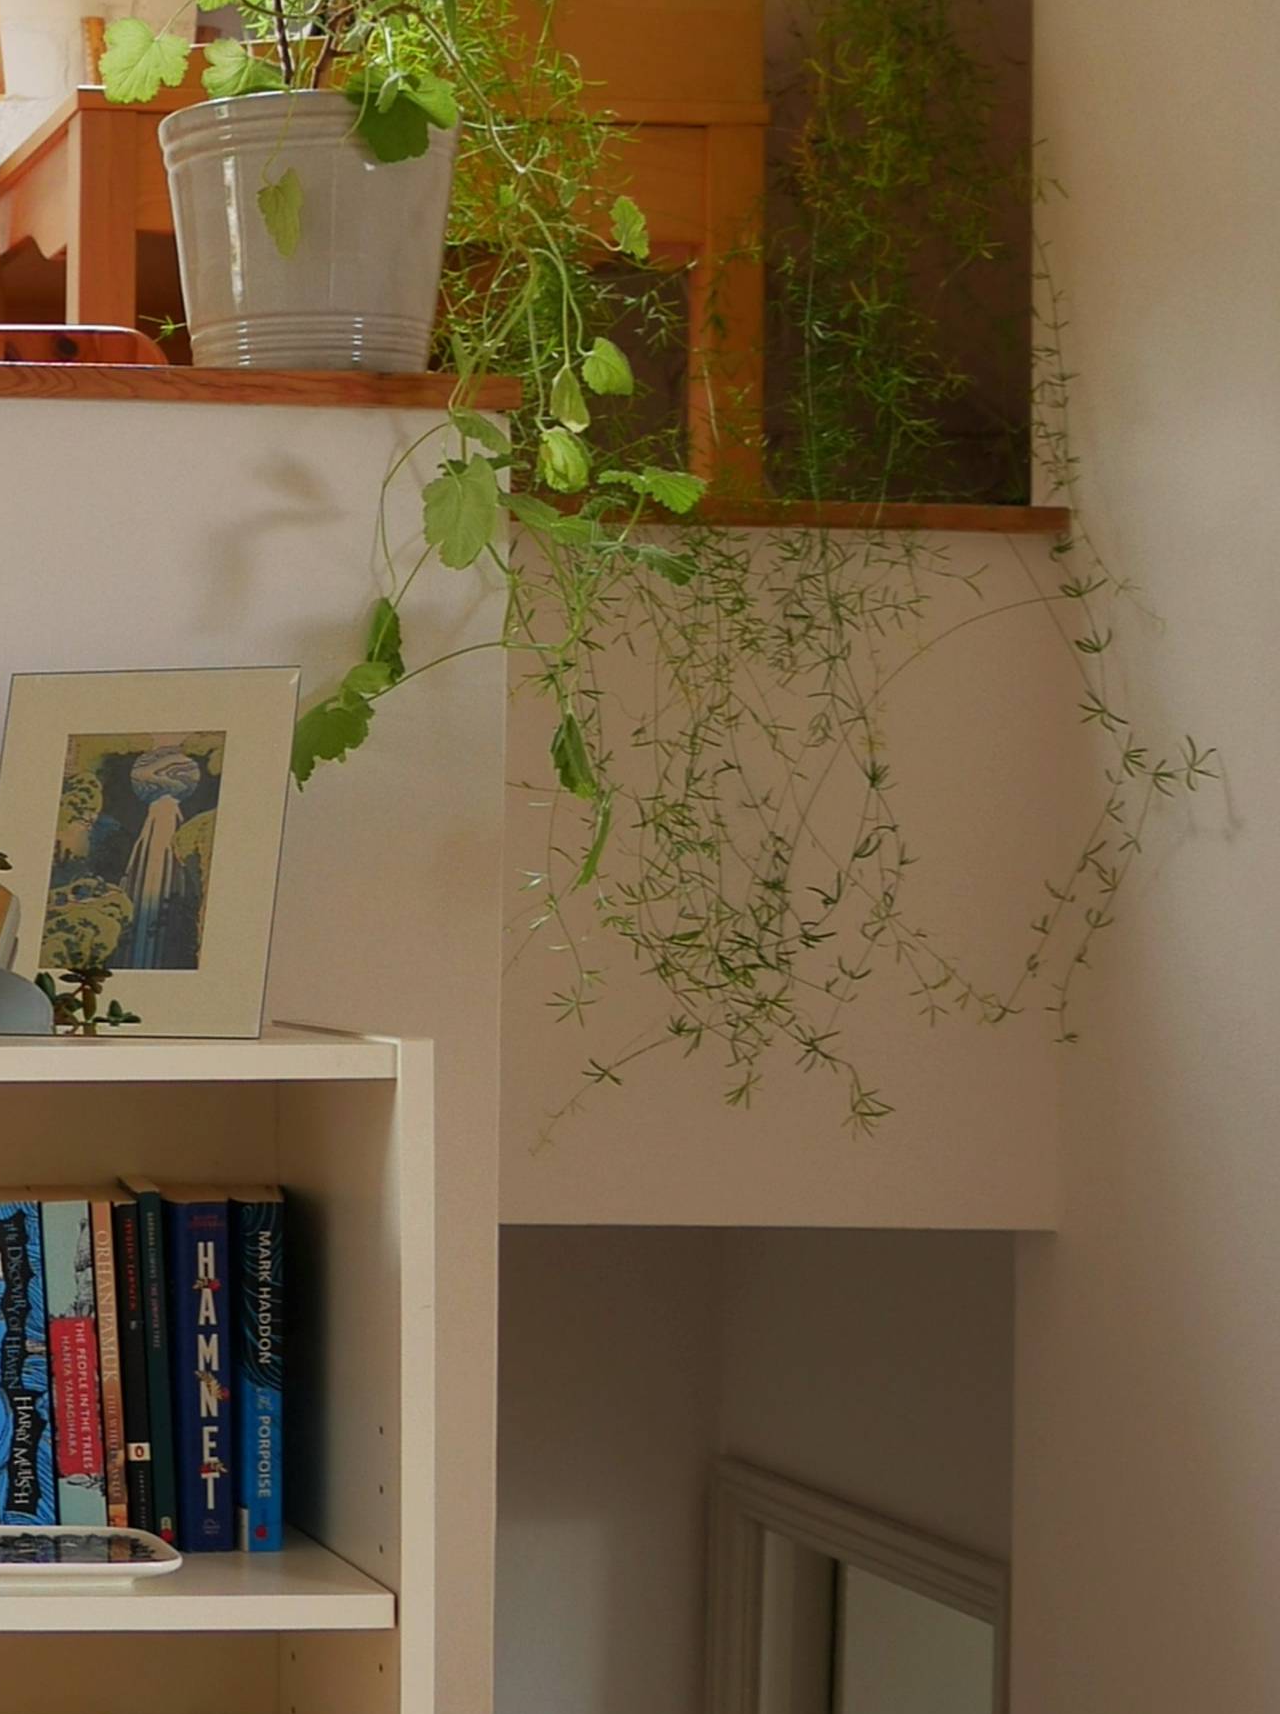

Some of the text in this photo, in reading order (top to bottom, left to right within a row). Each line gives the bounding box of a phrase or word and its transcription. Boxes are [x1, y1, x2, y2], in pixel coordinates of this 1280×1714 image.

[94, 1230, 116, 1383] ORHAN PAMUK
[257, 1231, 270, 1282] MARK
[196, 1241, 223, 1510] HAMNET
[257, 1287, 270, 1364] HADDON
[61, 1336, 76, 1455] HANYA YANAGIHARA
[74, 1322, 92, 1469] THE PEOPLE IN THE TREES
[257, 1415, 270, 1497] PORPOISE
